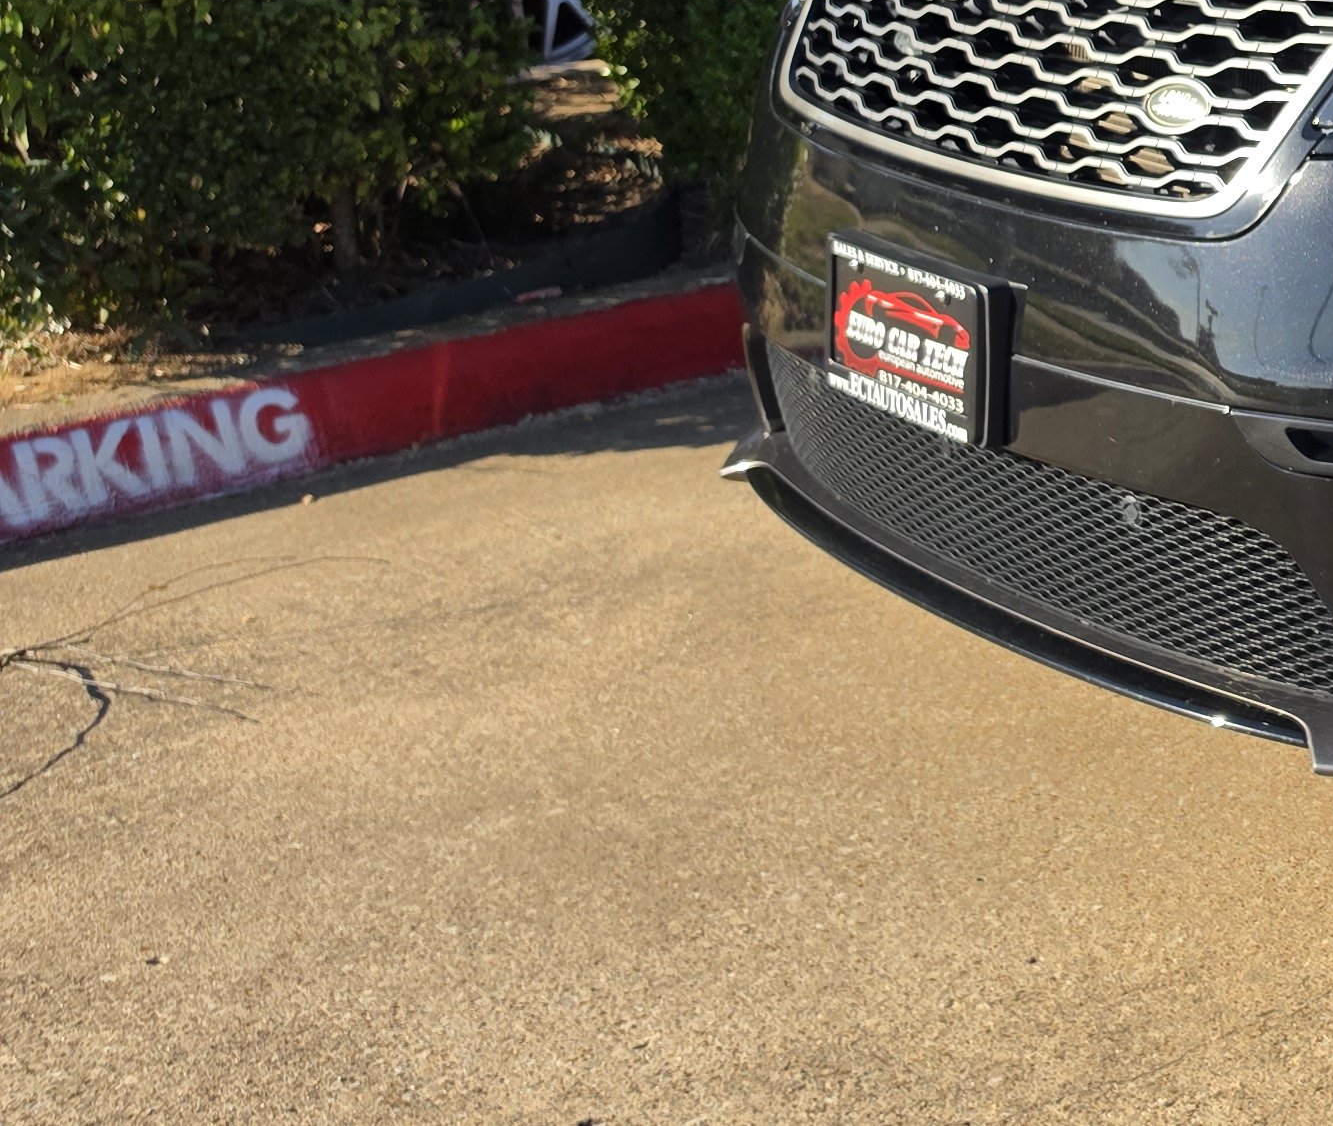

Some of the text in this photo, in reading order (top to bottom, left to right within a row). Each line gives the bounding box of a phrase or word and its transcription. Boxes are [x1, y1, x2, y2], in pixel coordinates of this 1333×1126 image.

[846, 310, 969, 378] EURO CAR TECH
[878, 370, 965, 414] 817-404-4033
[916, 363, 965, 389] automotive
[827, 371, 969, 443] www.ECTAUTOSALES.com
